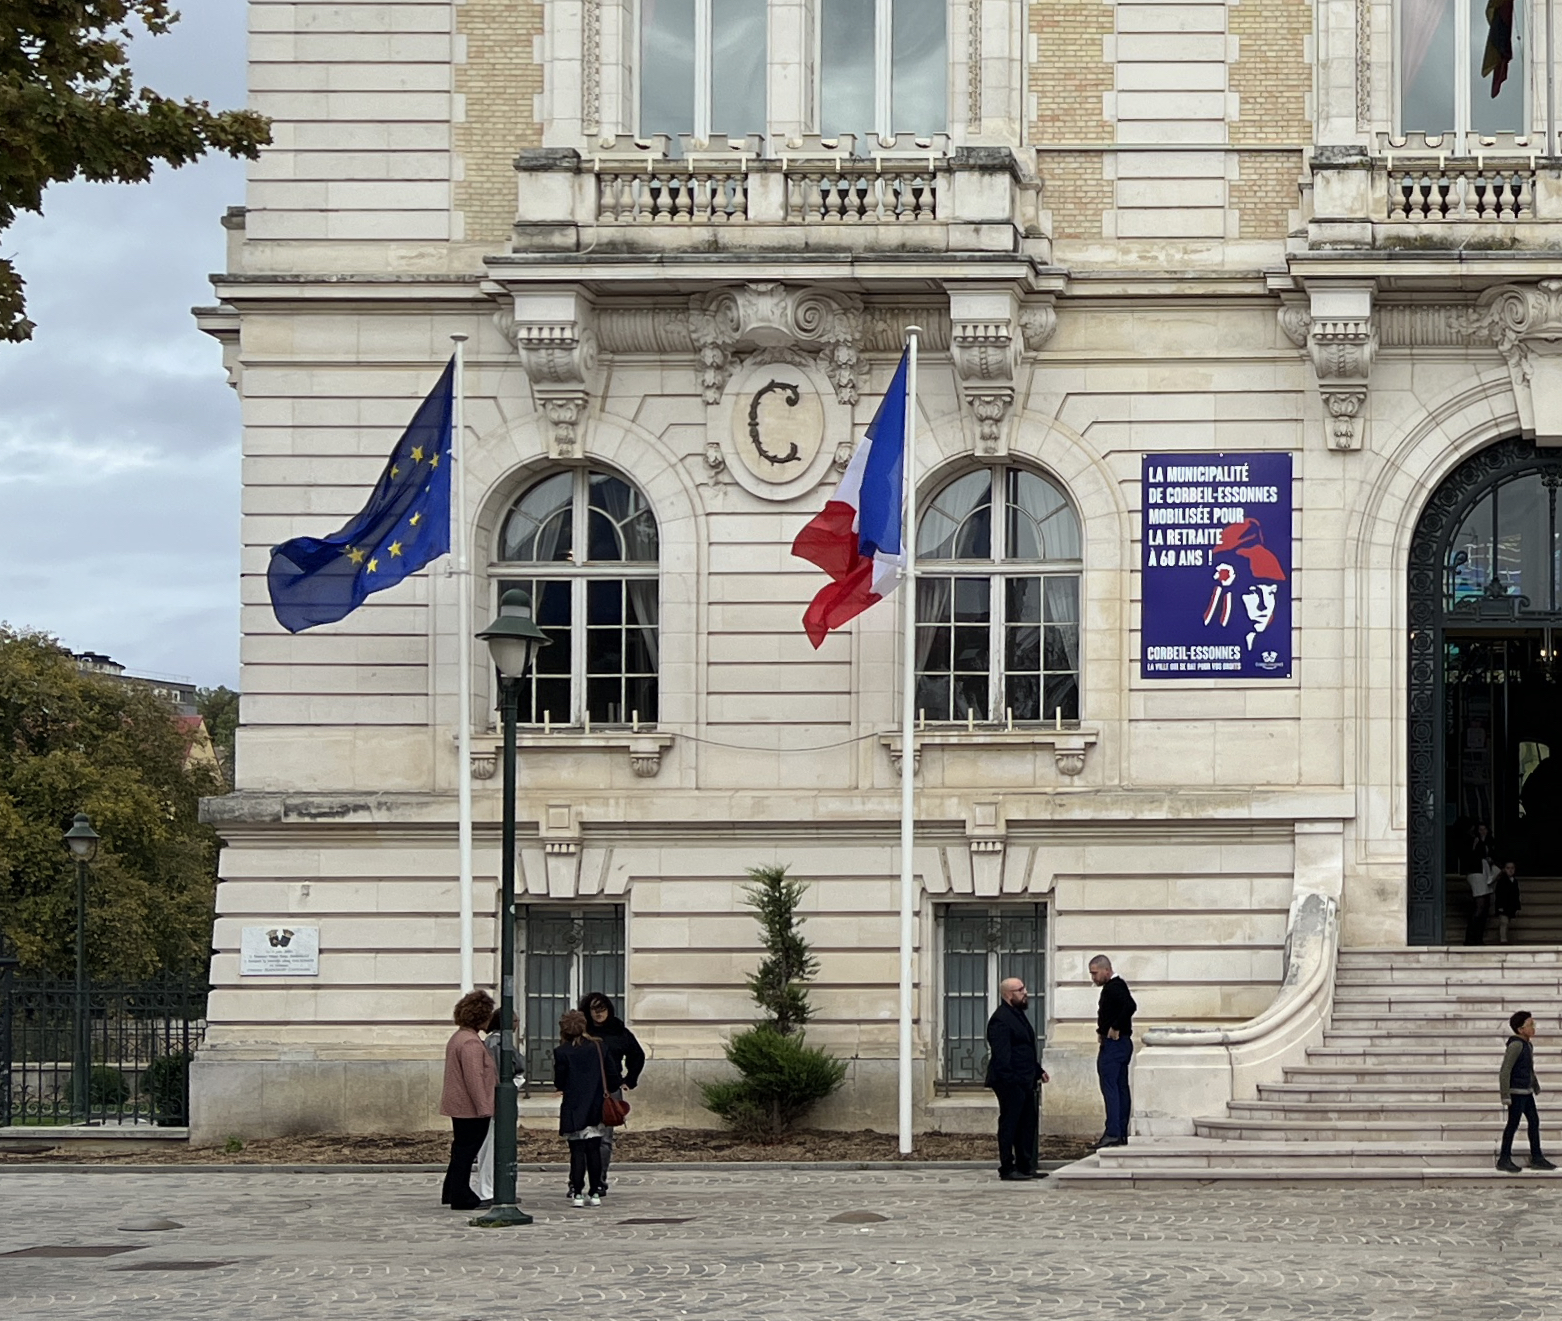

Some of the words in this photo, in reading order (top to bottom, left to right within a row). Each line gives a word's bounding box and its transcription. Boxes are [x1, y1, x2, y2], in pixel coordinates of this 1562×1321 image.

[1148, 466, 1164, 483] LA
[1166, 463, 1249, 482] MUNICIPALITÉ
[1148, 487, 1164, 504] DE
[1166, 486, 1278, 503] CORBEIL-ESSONNES
[1148, 505, 1211, 525] MOBILISÉE
[1213, 507, 1244, 524] POUR
[1148, 529, 1164, 546] LA
[1166, 528, 1224, 545] RETRAITE
[1148, 548, 1157, 567] À
[1159, 549, 1176, 566] 60
[1178, 549, 1203, 566] ANS
[1147, 645, 1241, 661] CORBEIL-ESSONNES
